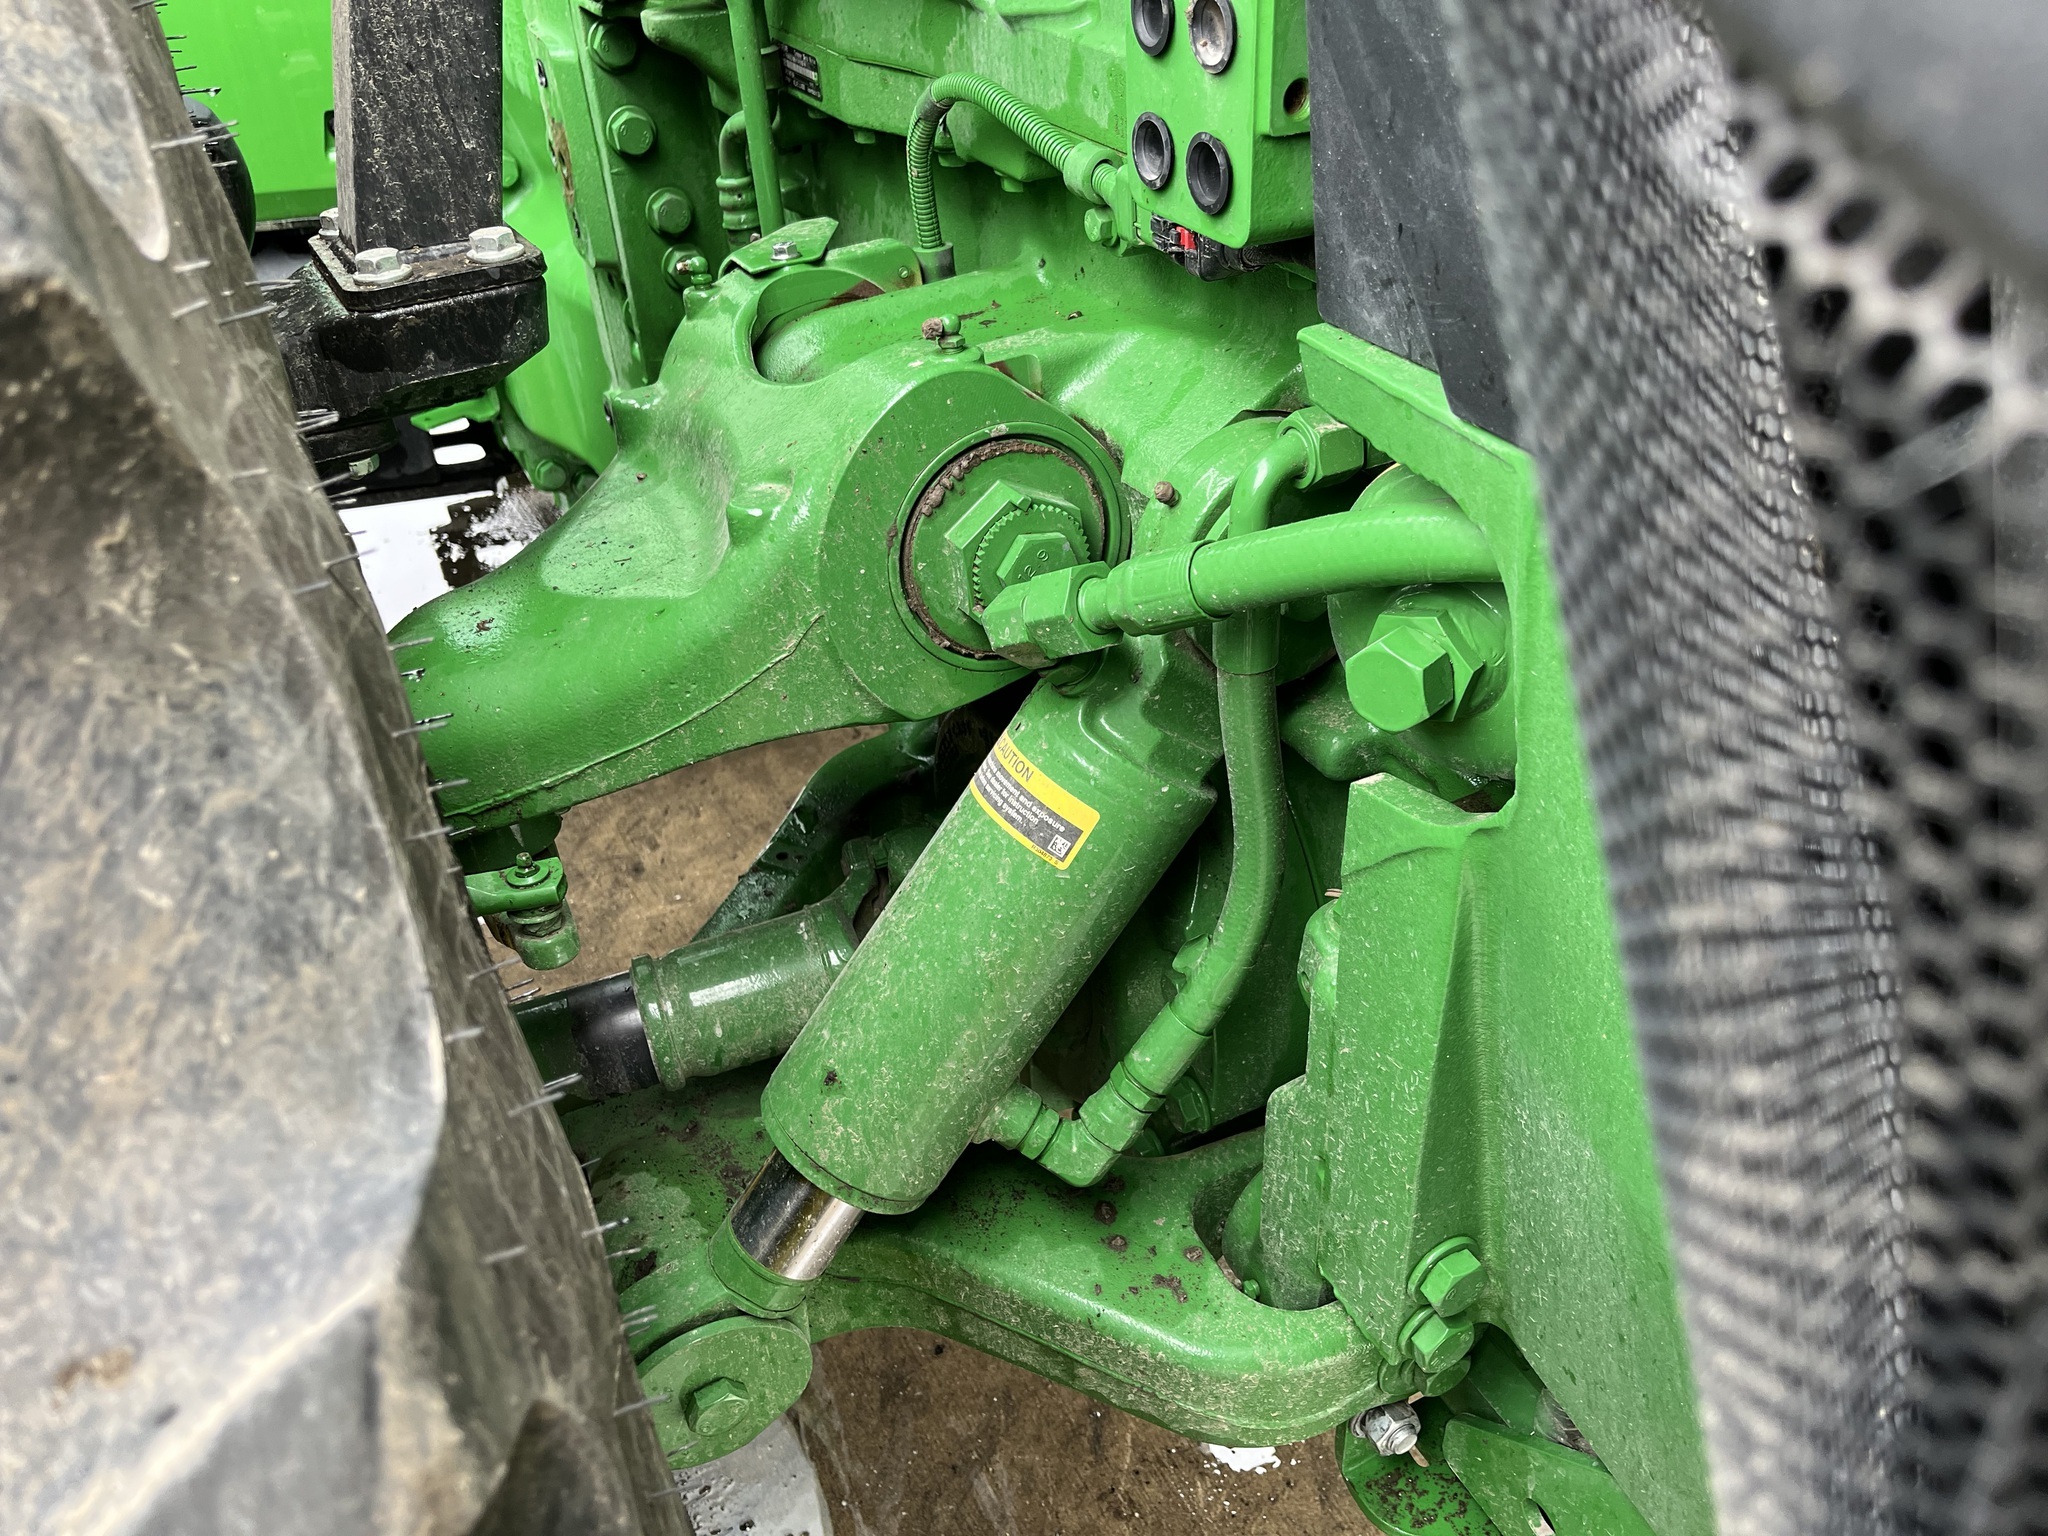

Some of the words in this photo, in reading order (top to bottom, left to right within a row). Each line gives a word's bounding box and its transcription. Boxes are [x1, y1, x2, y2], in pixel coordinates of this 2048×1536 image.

[998, 738, 1034, 782] CAUTION
[985, 784, 1003, 807] servicing
[995, 770, 1021, 798] movement
[1018, 795, 1033, 807] and
[1032, 806, 1065, 832] exposure
[1001, 788, 1009, 798] for
